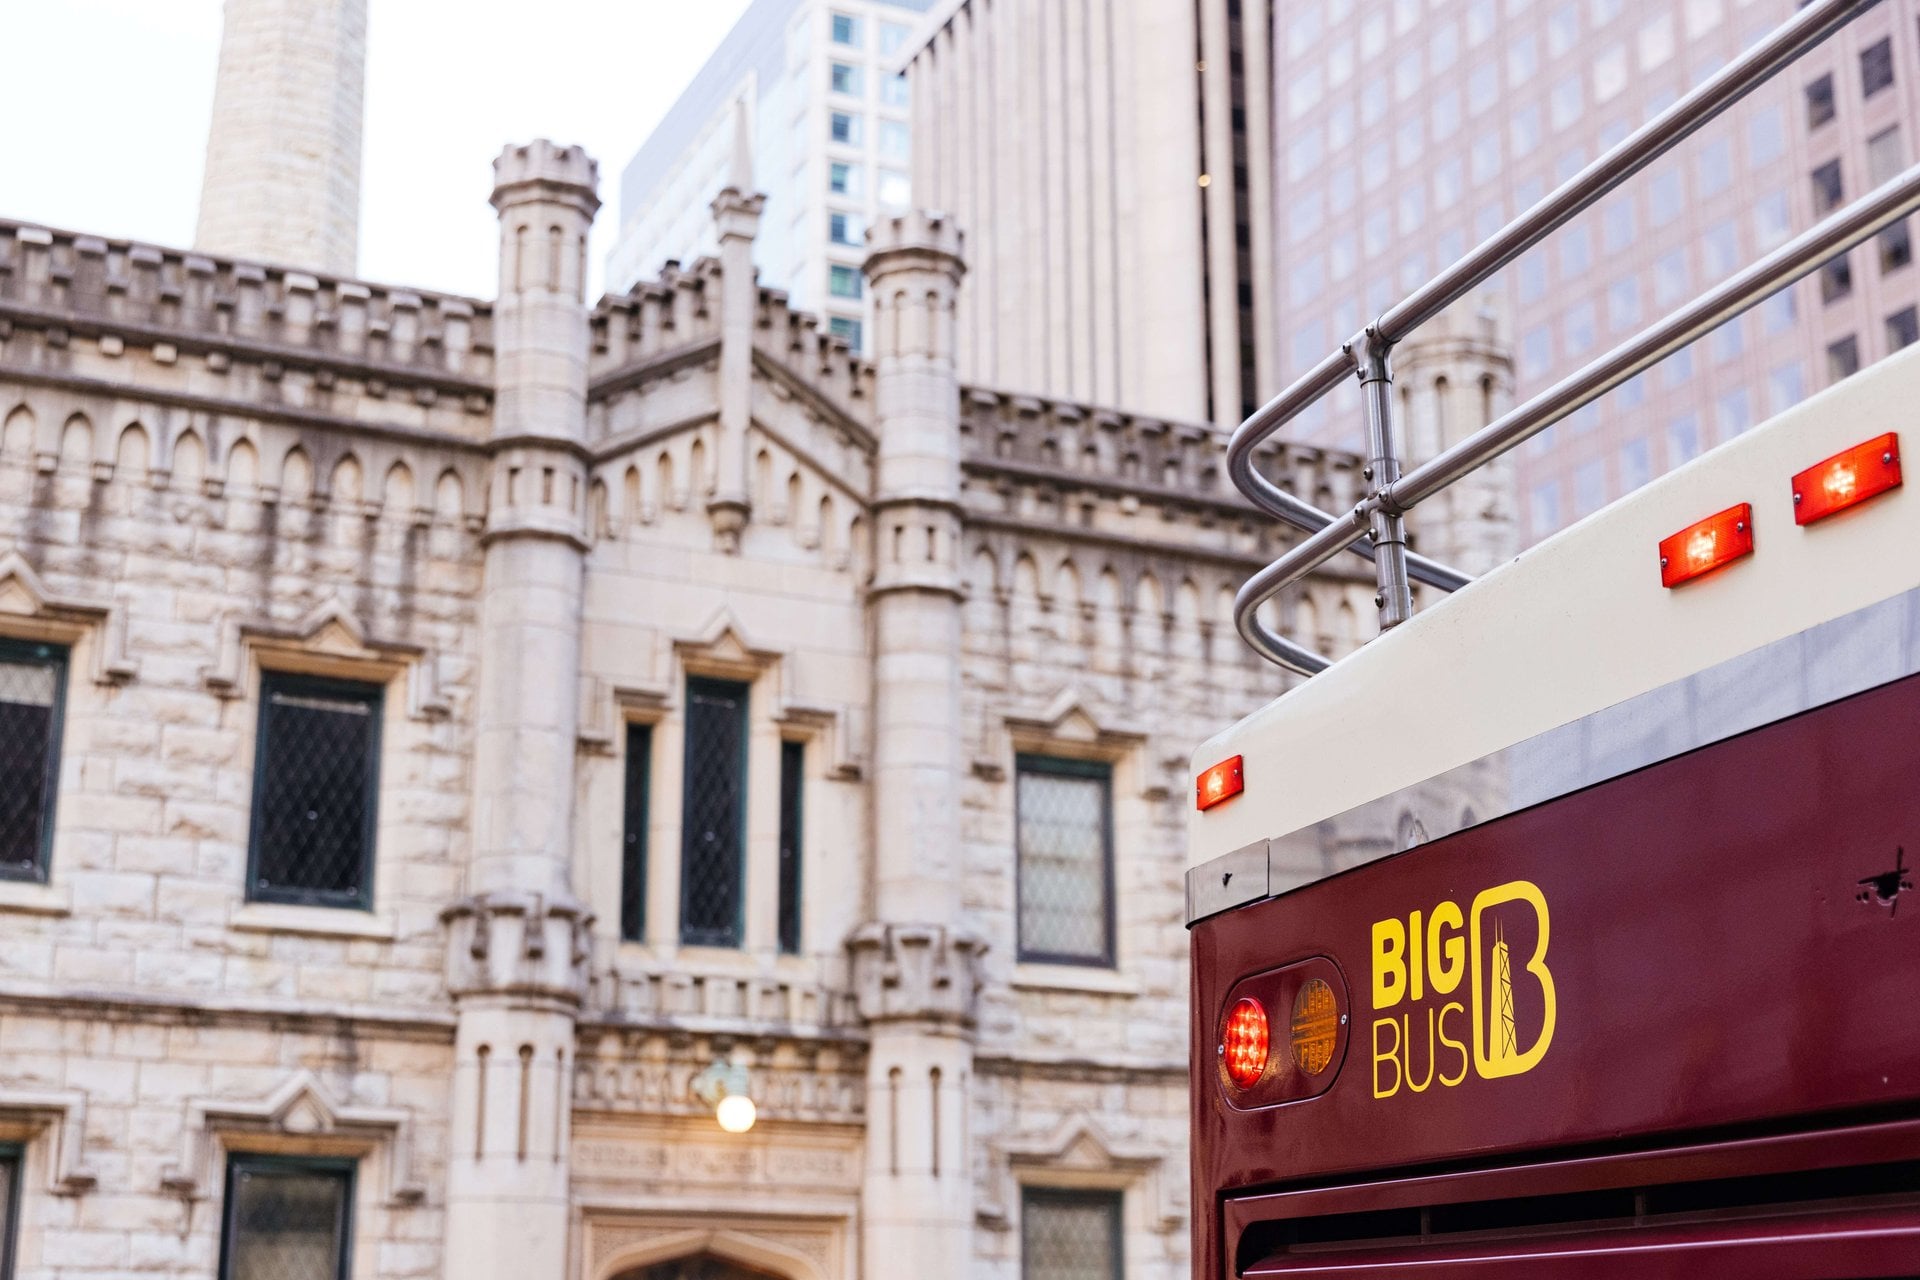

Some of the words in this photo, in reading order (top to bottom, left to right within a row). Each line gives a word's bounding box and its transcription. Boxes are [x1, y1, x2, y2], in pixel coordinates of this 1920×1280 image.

[1371, 900, 1466, 1010] BIG
[1470, 880, 1556, 1079] B
[1373, 1001, 1469, 1099] BUS
